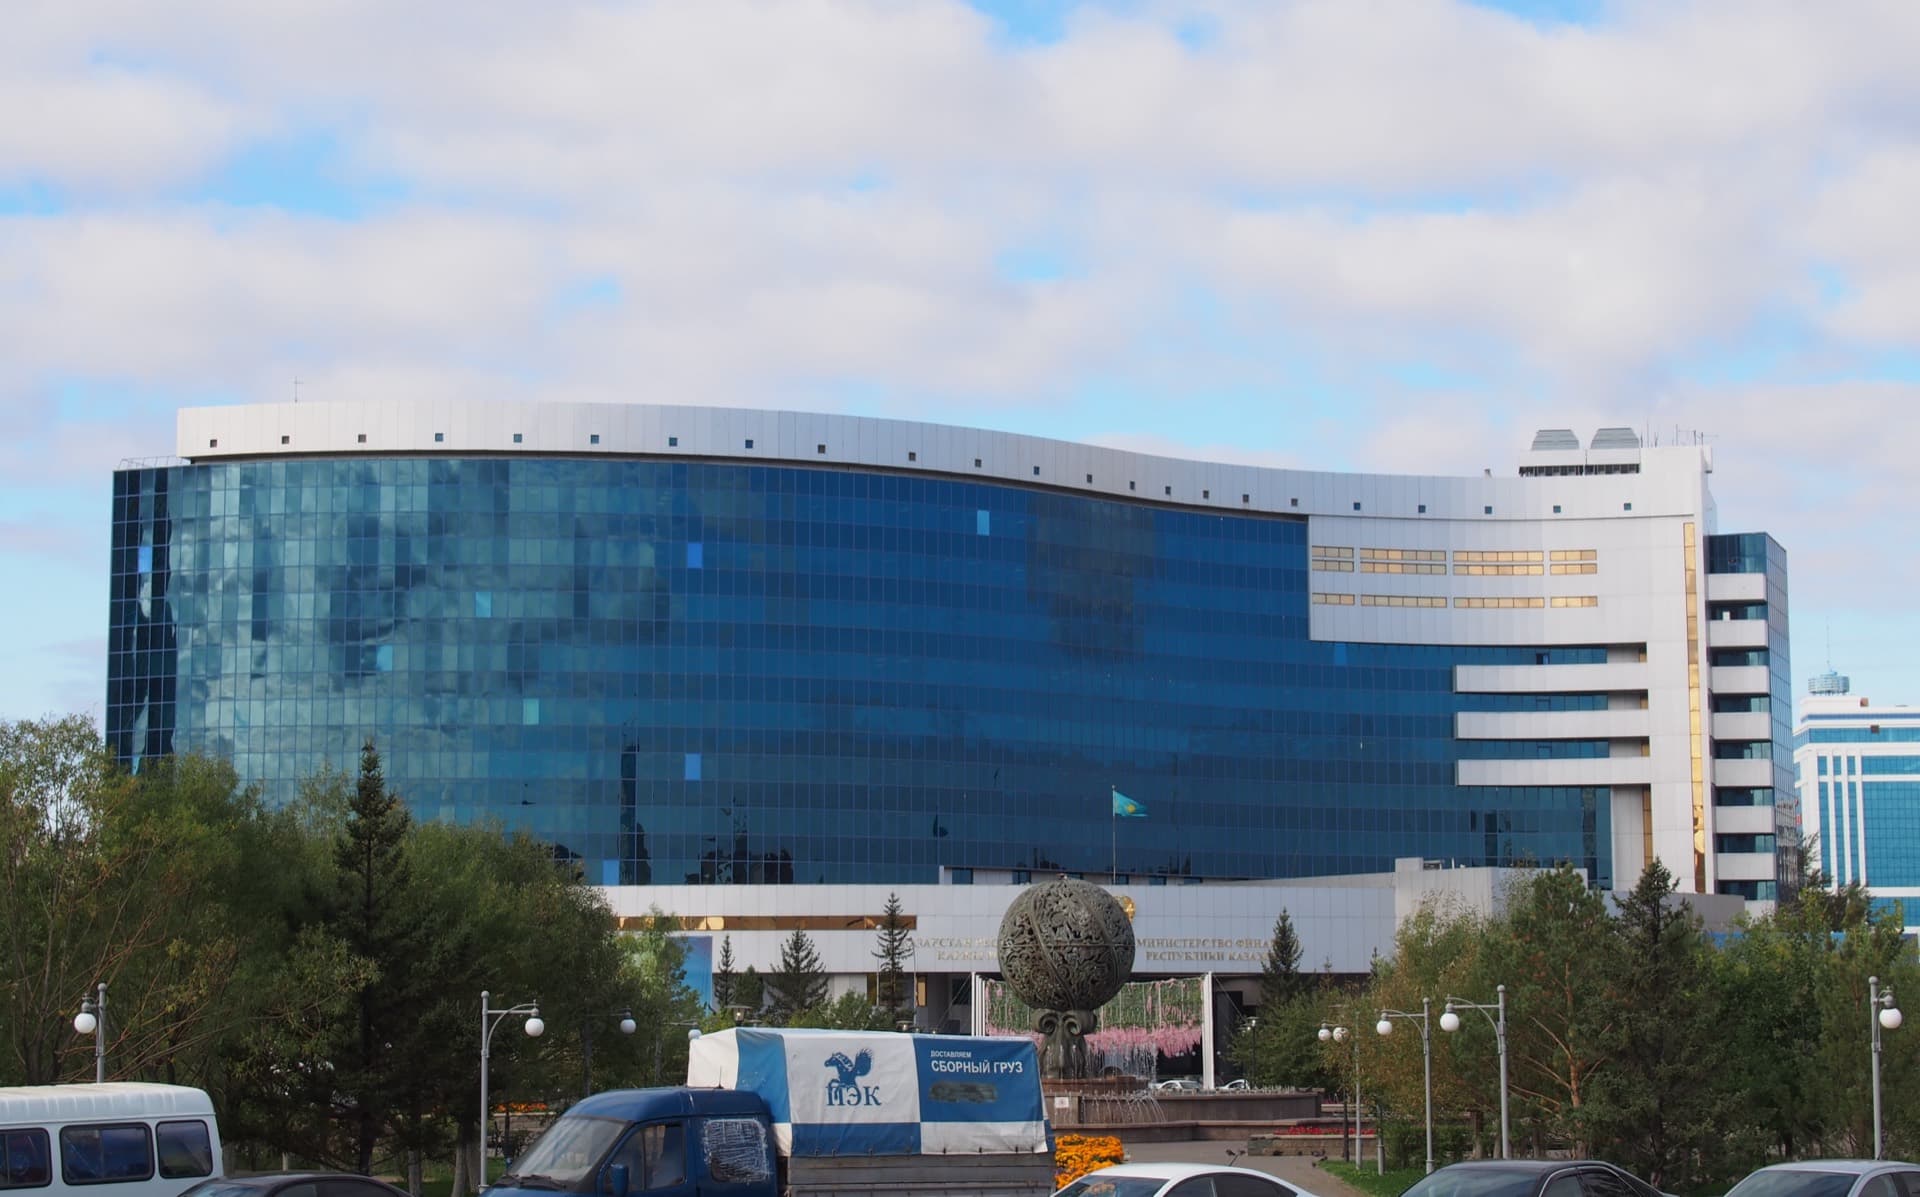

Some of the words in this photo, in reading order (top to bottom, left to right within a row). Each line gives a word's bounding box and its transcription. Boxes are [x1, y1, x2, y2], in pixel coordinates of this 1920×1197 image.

[1136, 938, 1232, 947] МИНИСТЕРСТВО
[1145, 951, 1225, 961] РЕСПУБЛИКИ
[930, 1050, 972, 1059] ДОСТАВЛЯЕМ
[931, 1059, 991, 1074] СБОРНЫЙ
[993, 1060, 1024, 1074] ГРУЗ
[825, 1085, 882, 1106] ПЭК
